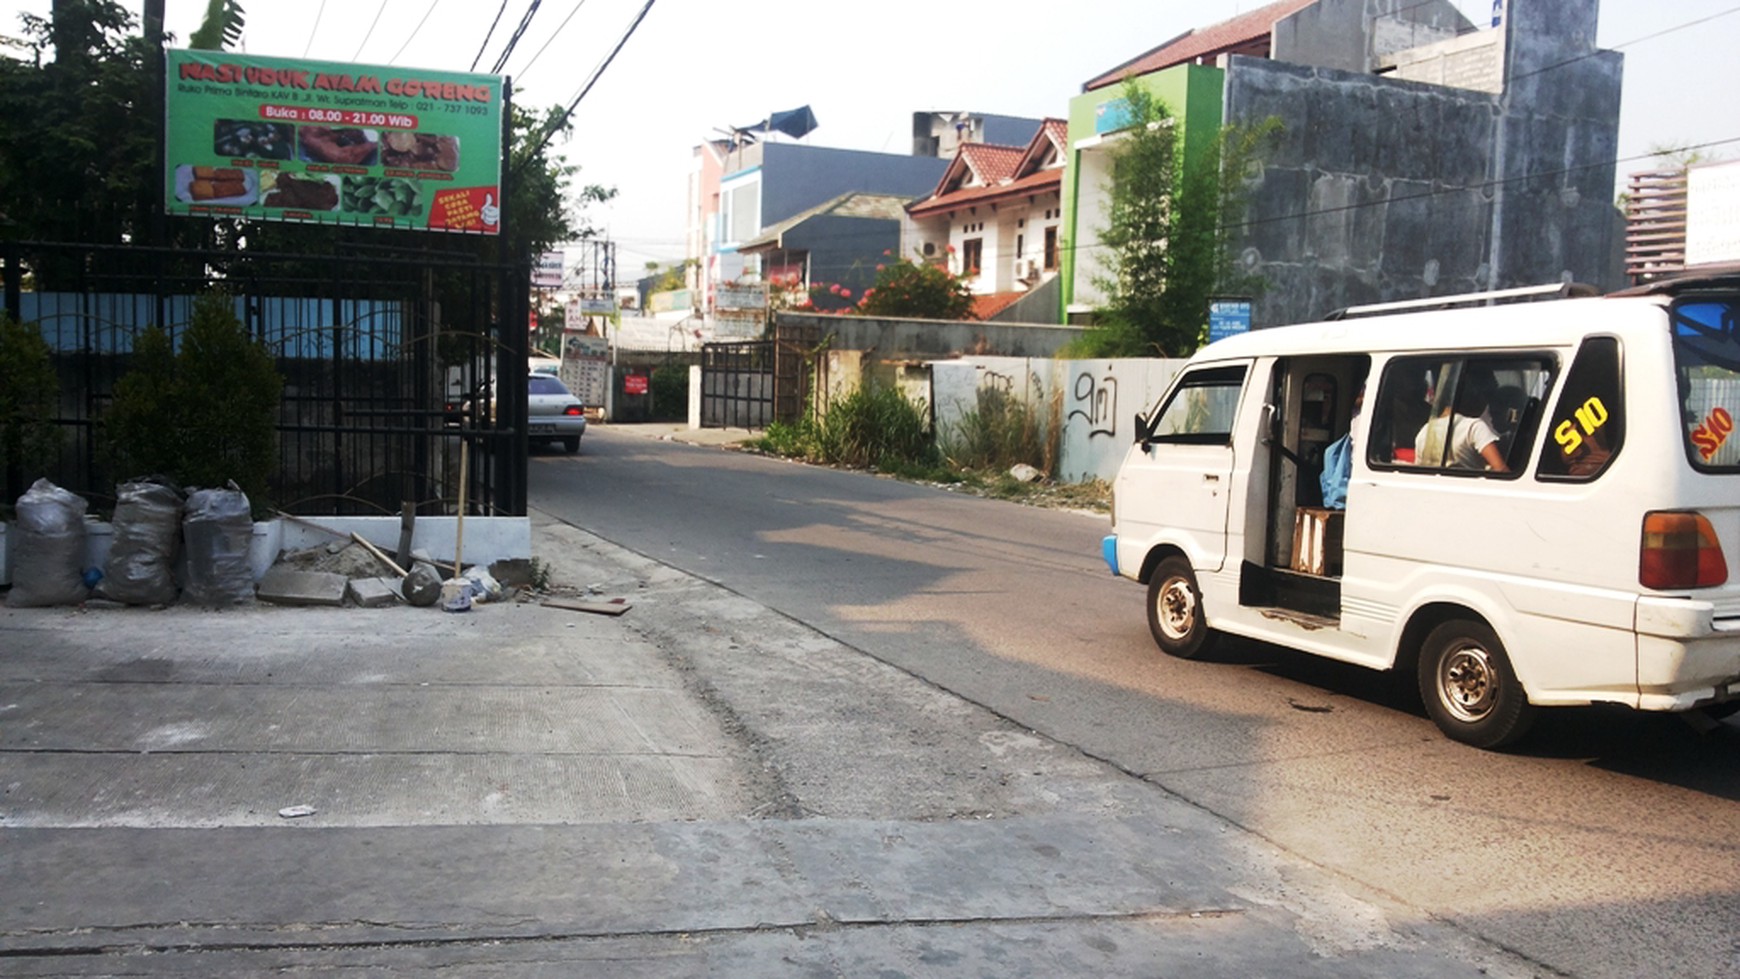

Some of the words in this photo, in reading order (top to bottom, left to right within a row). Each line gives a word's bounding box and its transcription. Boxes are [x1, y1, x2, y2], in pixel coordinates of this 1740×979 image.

[180, 62, 242, 83] NASI
[245, 66, 310, 89] UDUK
[313, 72, 381, 94] AYAM
[385, 78, 491, 102] GORENG
[271, 90, 289, 100] KAV
[334, 95, 387, 109] Supratman
[416, 101, 433, 111] 021
[465, 105, 488, 116] 1093
[266, 106, 298, 119] Buka
[308, 109, 342, 122] 08.00
[352, 113, 385, 125] 21.00
[388, 115, 412, 127] Wib
